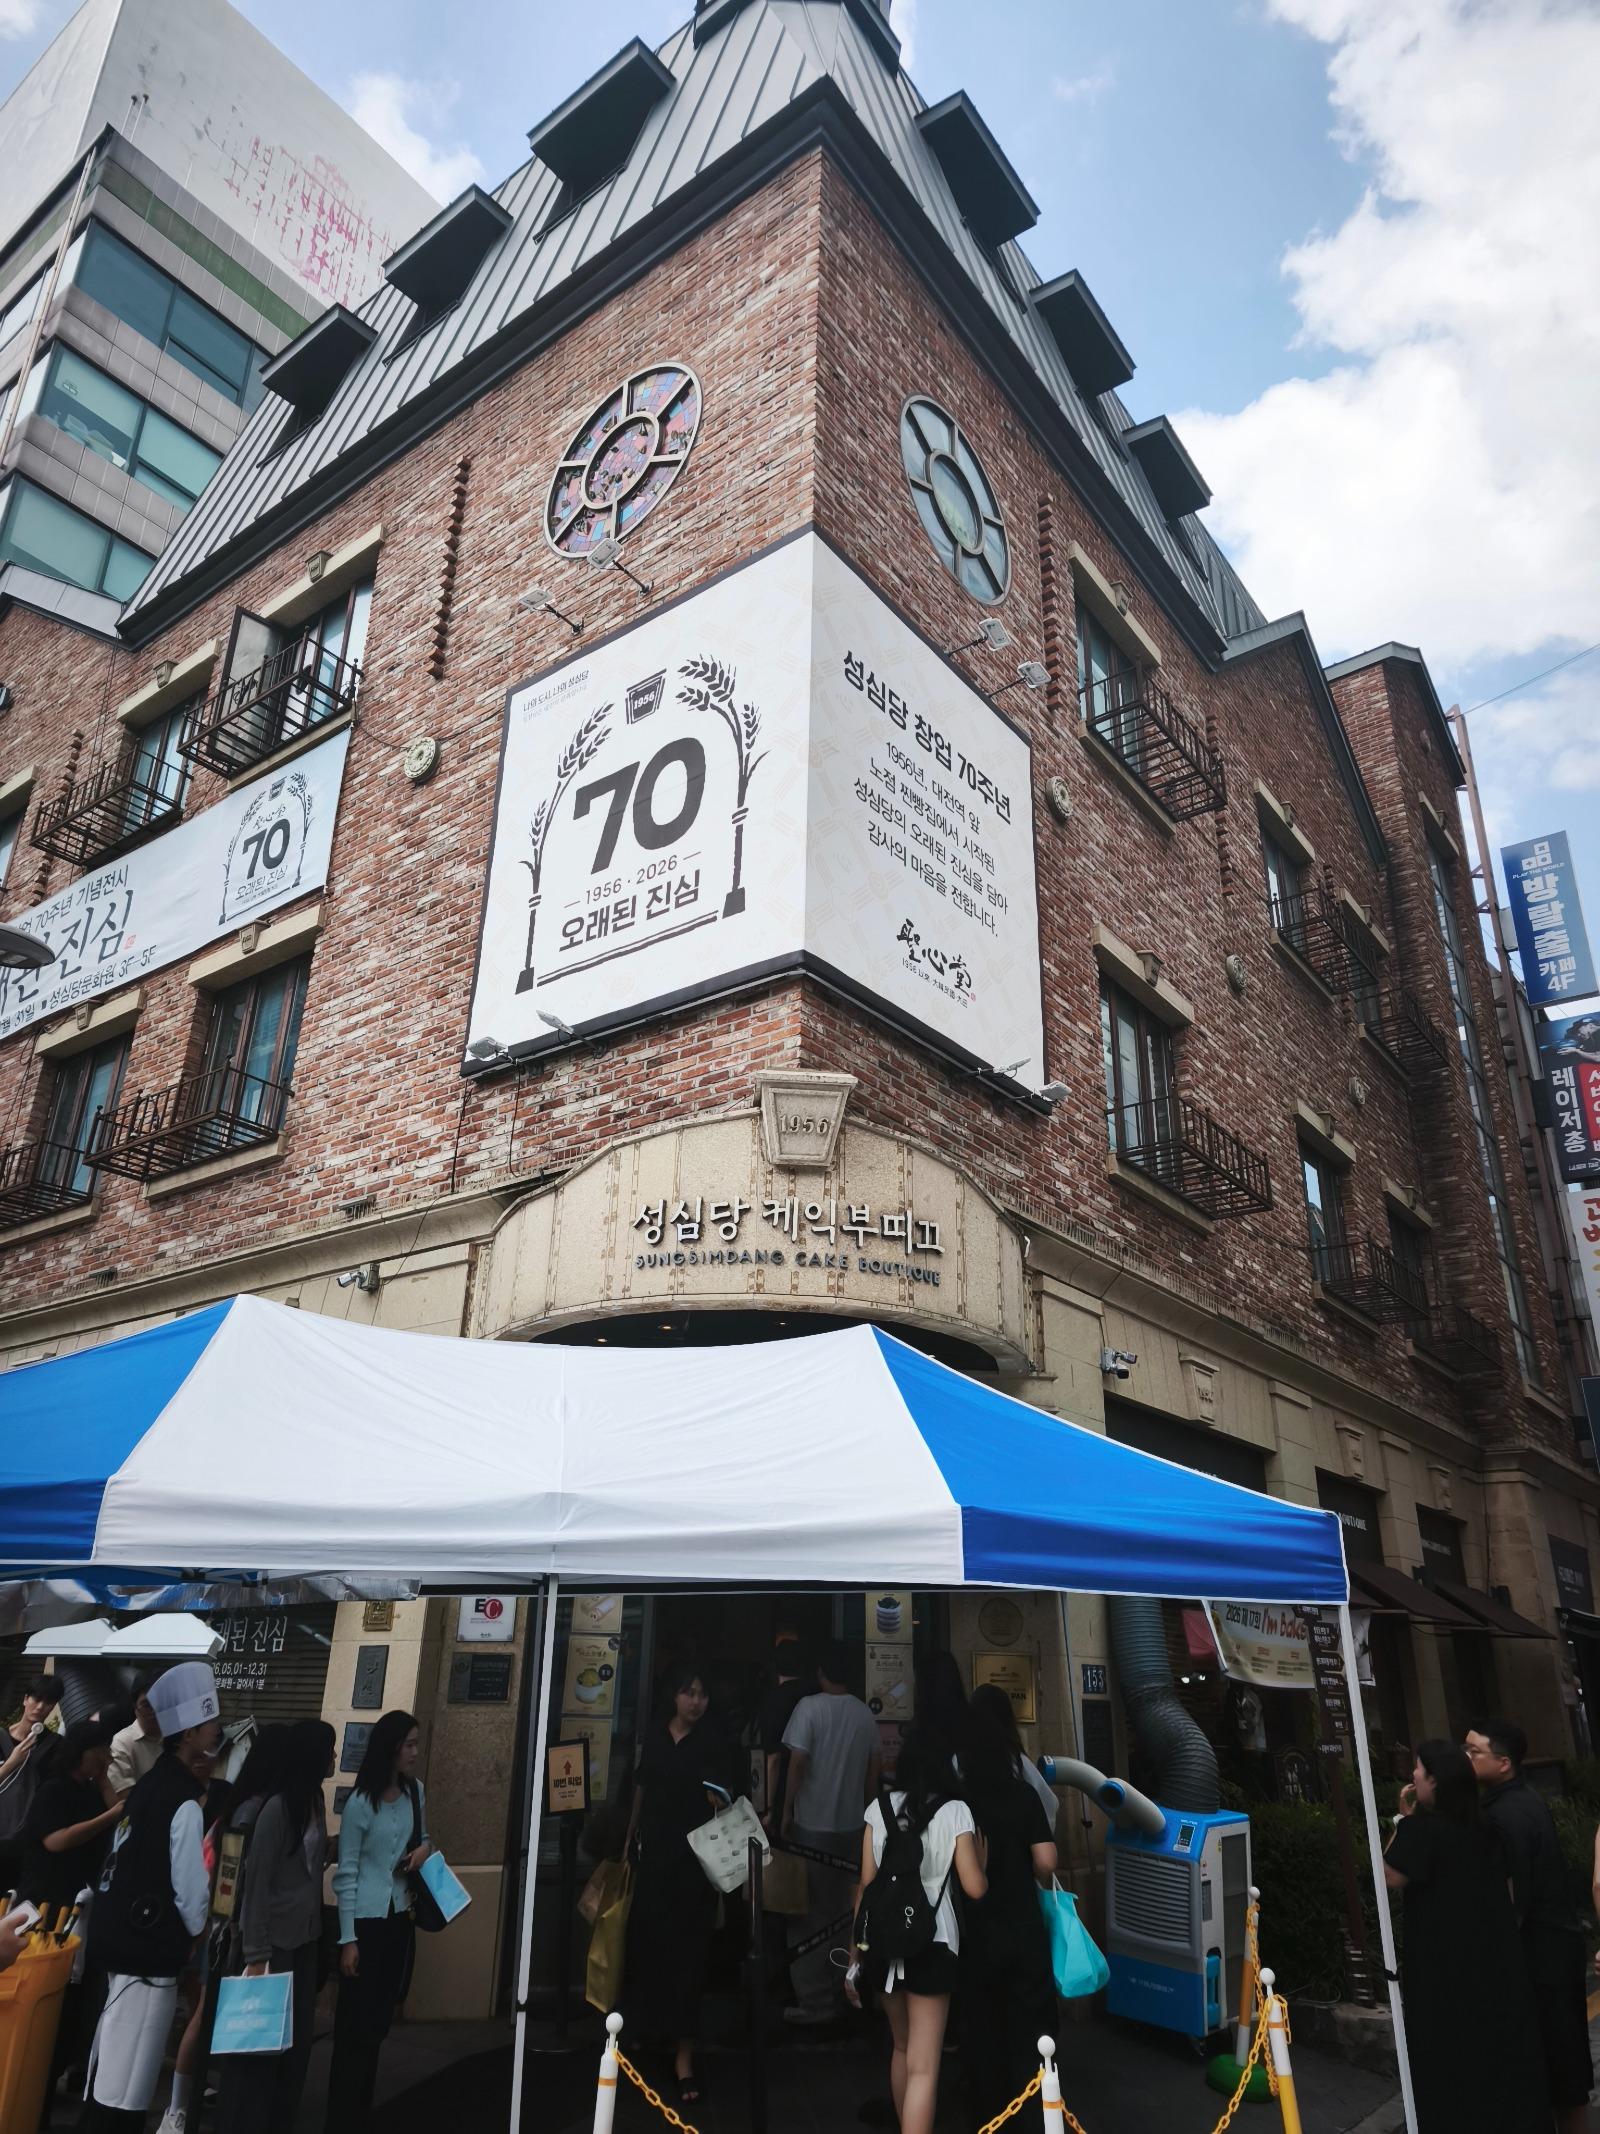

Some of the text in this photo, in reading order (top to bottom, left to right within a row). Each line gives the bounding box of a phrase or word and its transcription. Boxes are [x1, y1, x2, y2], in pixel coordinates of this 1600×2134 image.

[633, 689, 655, 710] 1956
[844, 650, 1011, 825] 성심당 창업 70주년
[572, 737, 707, 875] 70
[870, 757, 995, 876] 노점 찐빵집에서 시작된
[886, 742, 981, 835] 1956년, 대전역 앞
[242, 818, 291, 880] 70
[854, 777, 1008, 915] 성심당의 오래된 진심을 담아
[867, 820, 998, 938] 감사의 마음을 전합니다.
[35, 893, 73, 933] 70주년
[76, 863, 129, 906] 기념전시
[235, 875, 266, 901] 오래된
[266, 864, 289, 887] 진심
[559, 869, 700, 952] 오래된 진심
[585, 854, 678, 905] 1956 2026
[55, 890, 134, 980] 진심
[1522, 872, 1571, 960] 방탈출
[15, 1003, 35, 1028] 31일
[50, 962, 116, 1010] 성심당문화원
[1538, 956, 1577, 976] 카페
[1547, 972, 1576, 992] 4F
[779, 1113, 830, 1135] 1956
[1551, 1066, 1588, 1153] 레이저총
[632, 1196, 946, 1256] 성심당 케익부띠끄
[635, 1250, 942, 1286] SUNGSIMDANG CAKE BOUTIQUE
[251, 1616, 288, 1653] 진심
[213, 1662, 267, 1676] 6.05.01-12.31
